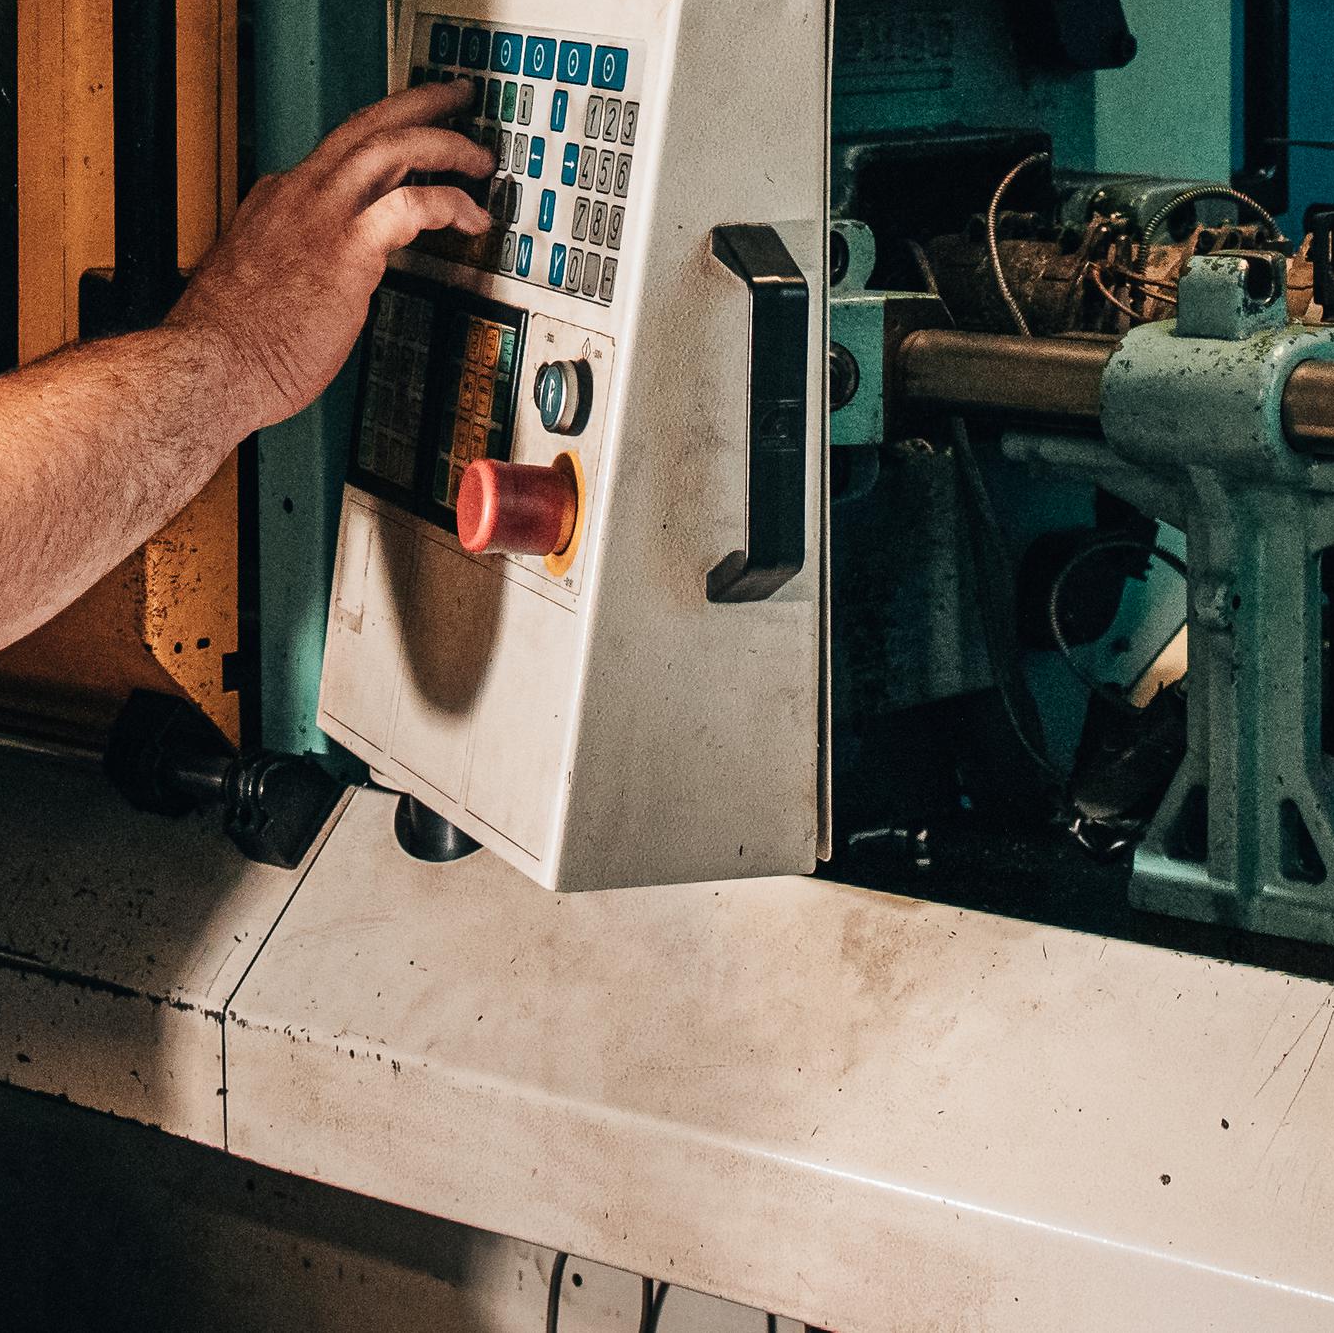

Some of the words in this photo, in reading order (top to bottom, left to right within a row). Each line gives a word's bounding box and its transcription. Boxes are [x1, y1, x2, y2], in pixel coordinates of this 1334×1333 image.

[590, 104, 598, 132] 1
[605, 107, 617, 136] 2
[624, 110, 635, 138] 3
[581, 153, 591, 181] 4
[599, 157, 611, 186] 5
[617, 162, 628, 190] 6
[575, 203, 587, 232] 7
[593, 208, 602, 237] 8
[610, 212, 621, 241] 9
[517, 241, 530, 266] N
[553, 250, 564, 279] Y
[569, 256, 579, 283] 0
